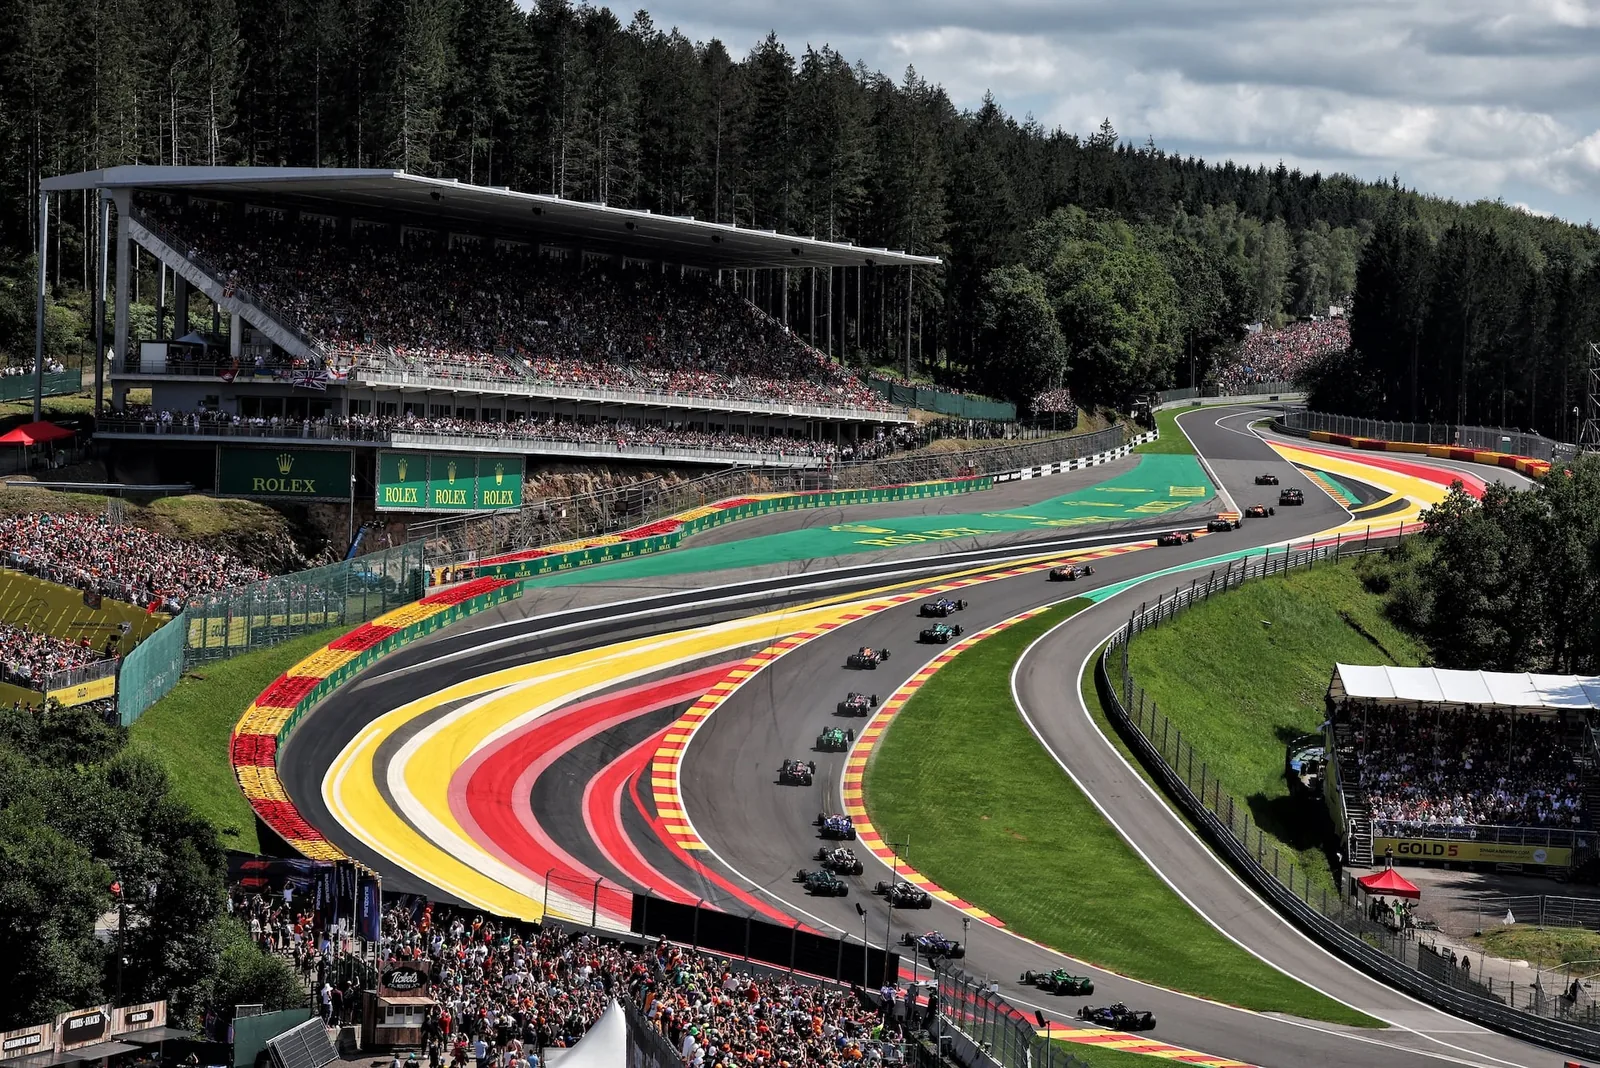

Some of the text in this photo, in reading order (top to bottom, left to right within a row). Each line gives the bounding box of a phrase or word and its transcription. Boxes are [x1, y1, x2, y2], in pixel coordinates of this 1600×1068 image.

[252, 478, 316, 493] ROLEX
[385, 487, 417, 502] ROLEX
[435, 489, 466, 504] ROLEX
[483, 490, 514, 504] ROLEX
[1398, 843, 1458, 856] GOLD 5
[392, 971, 418, 983] Tickets
